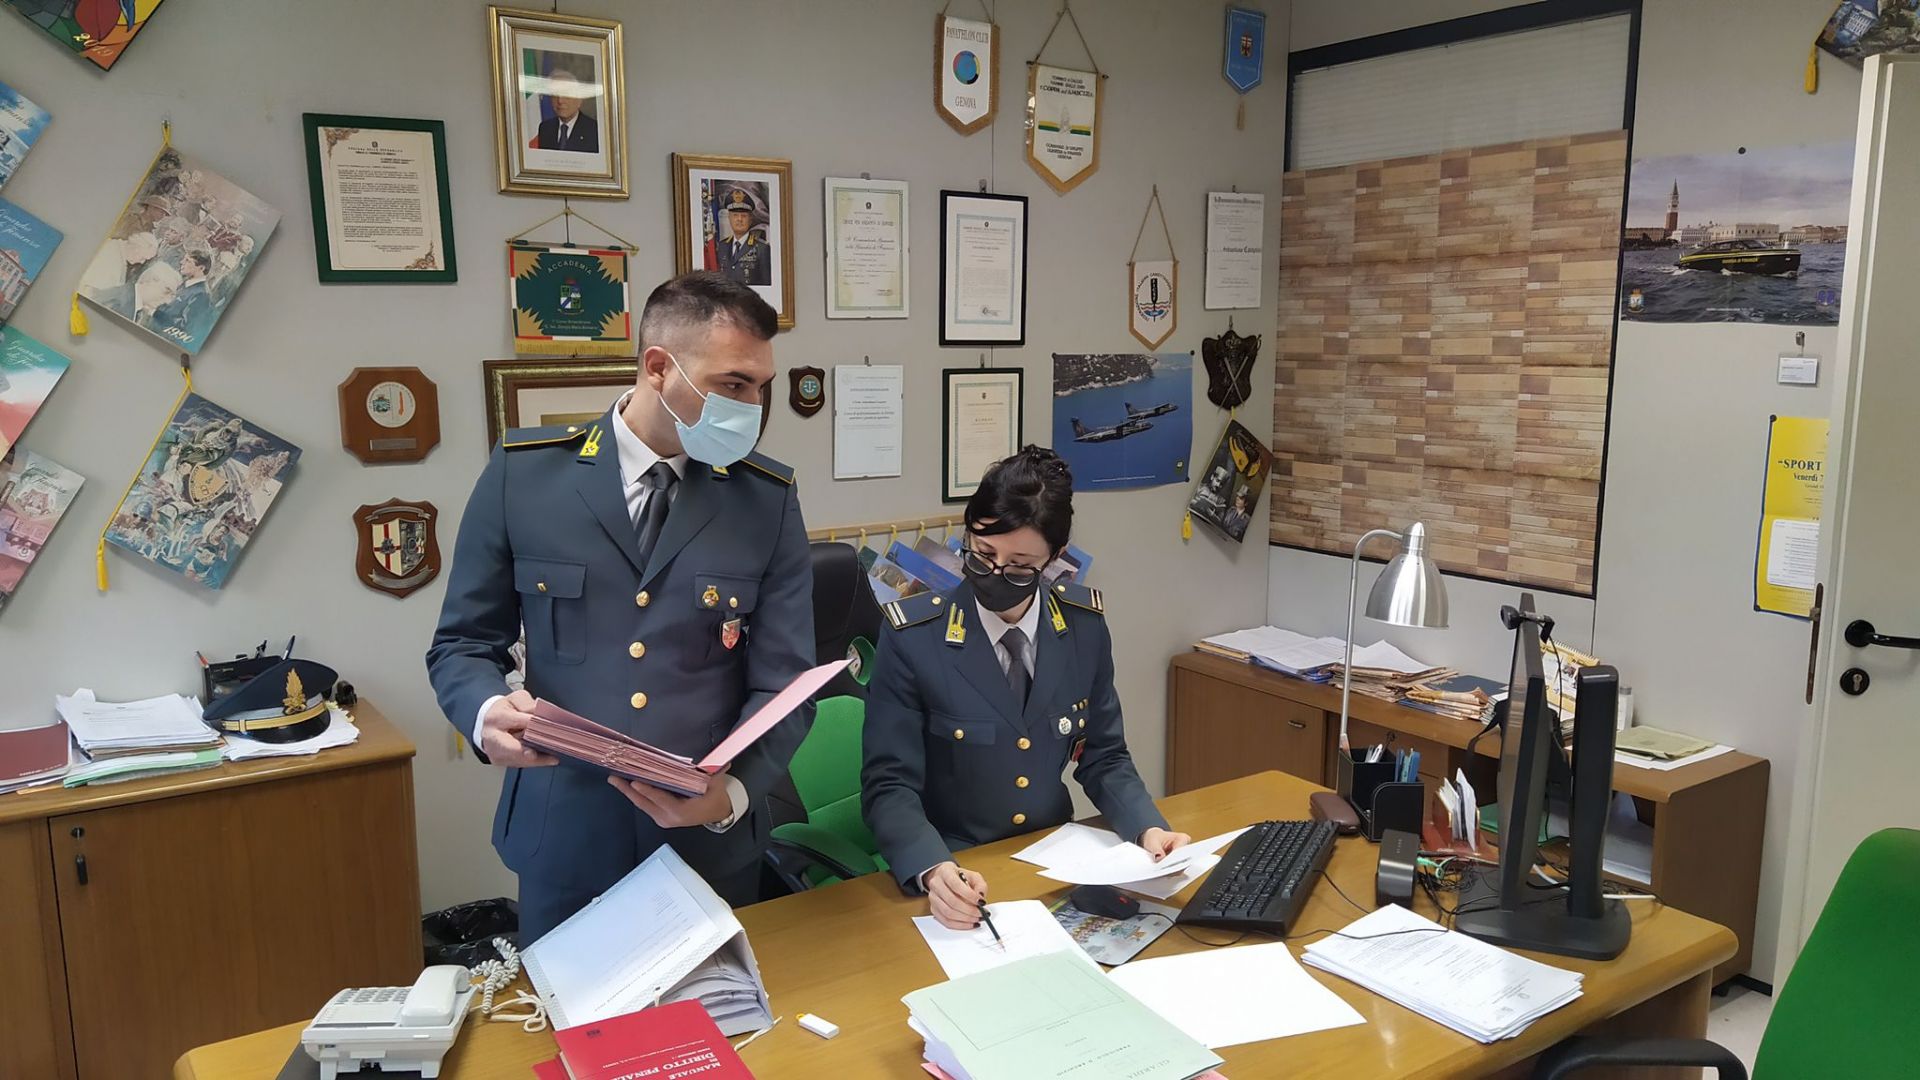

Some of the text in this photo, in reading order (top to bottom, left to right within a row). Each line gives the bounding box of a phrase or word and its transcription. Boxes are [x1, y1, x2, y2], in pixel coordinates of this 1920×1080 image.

[954, 95, 977, 109] GENOVA
[548, 260, 592, 275] ACCADEMIA
[163, 326, 193, 343] 1990
[662, 1052, 716, 1071] DIRITTO
[669, 1061, 721, 1080] MANUALE
